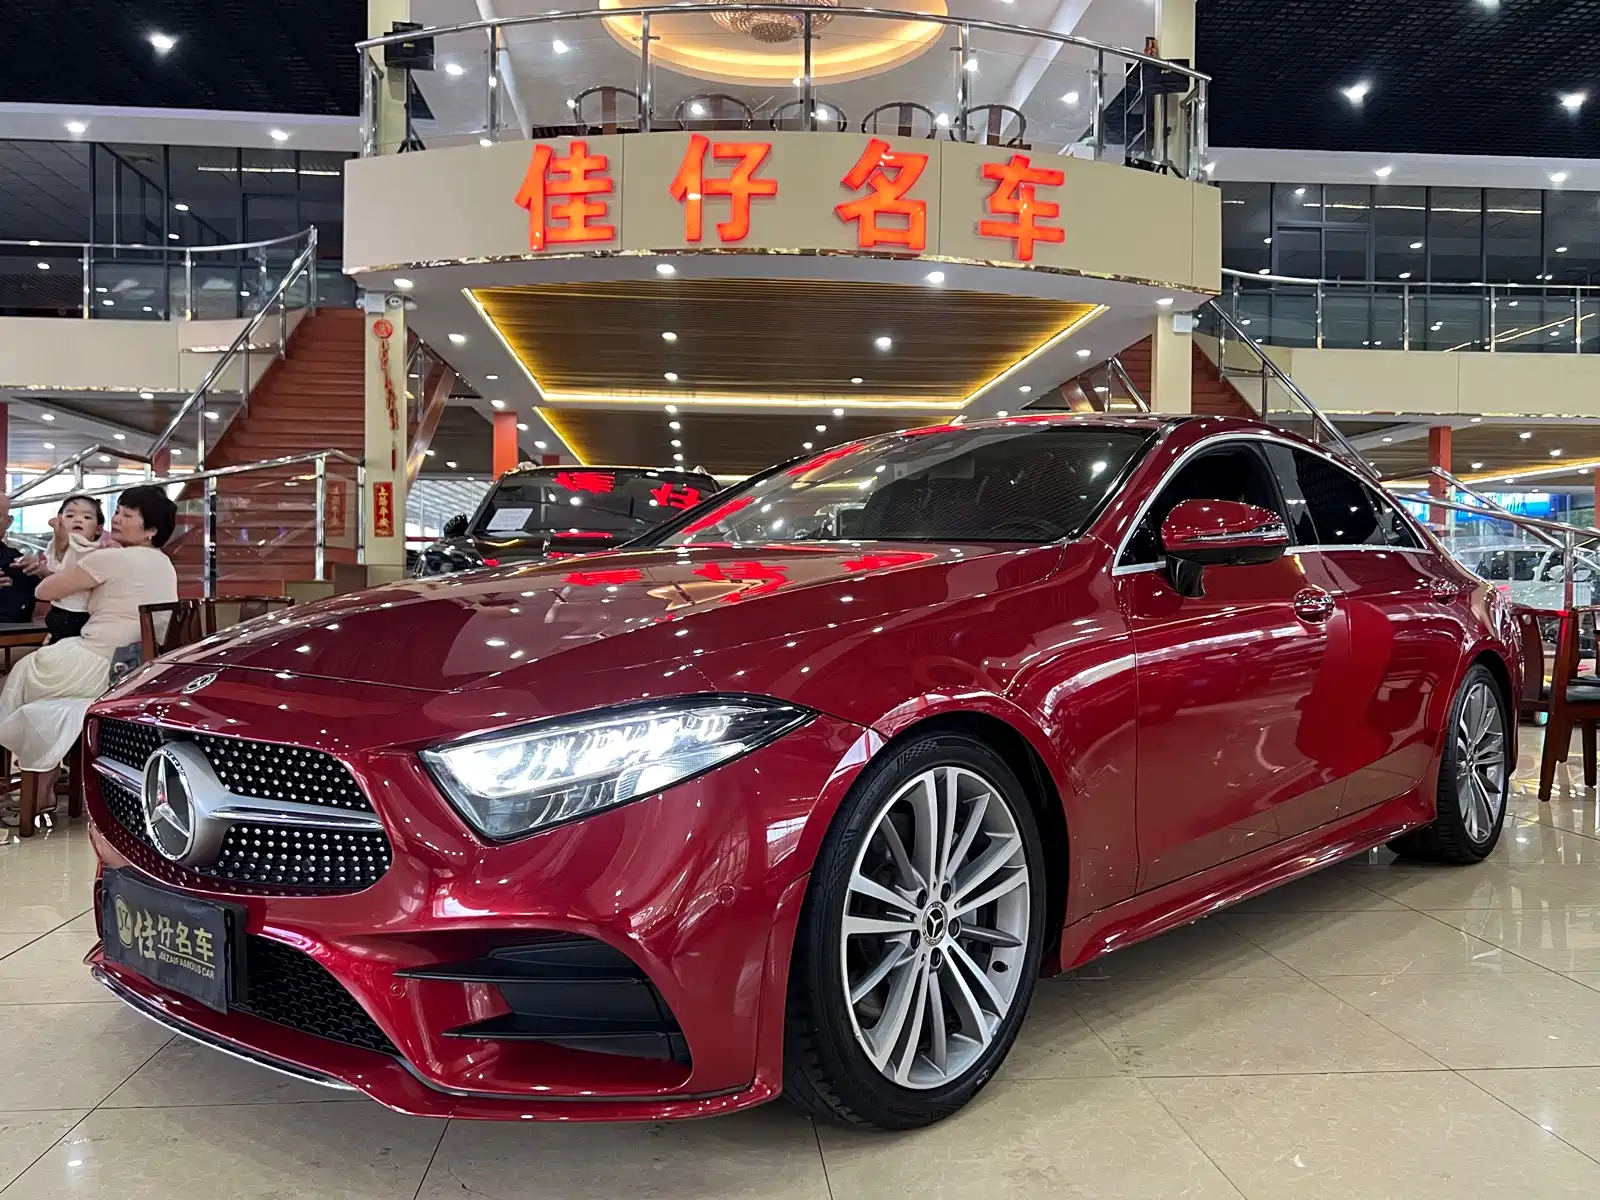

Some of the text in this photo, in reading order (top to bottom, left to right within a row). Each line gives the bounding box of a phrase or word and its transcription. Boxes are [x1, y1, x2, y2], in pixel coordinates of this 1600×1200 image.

[514, 134, 1065, 261] 佳仔名车
[134, 909, 214, 962] 佳仔名车
[201, 967, 215, 980] CAR
